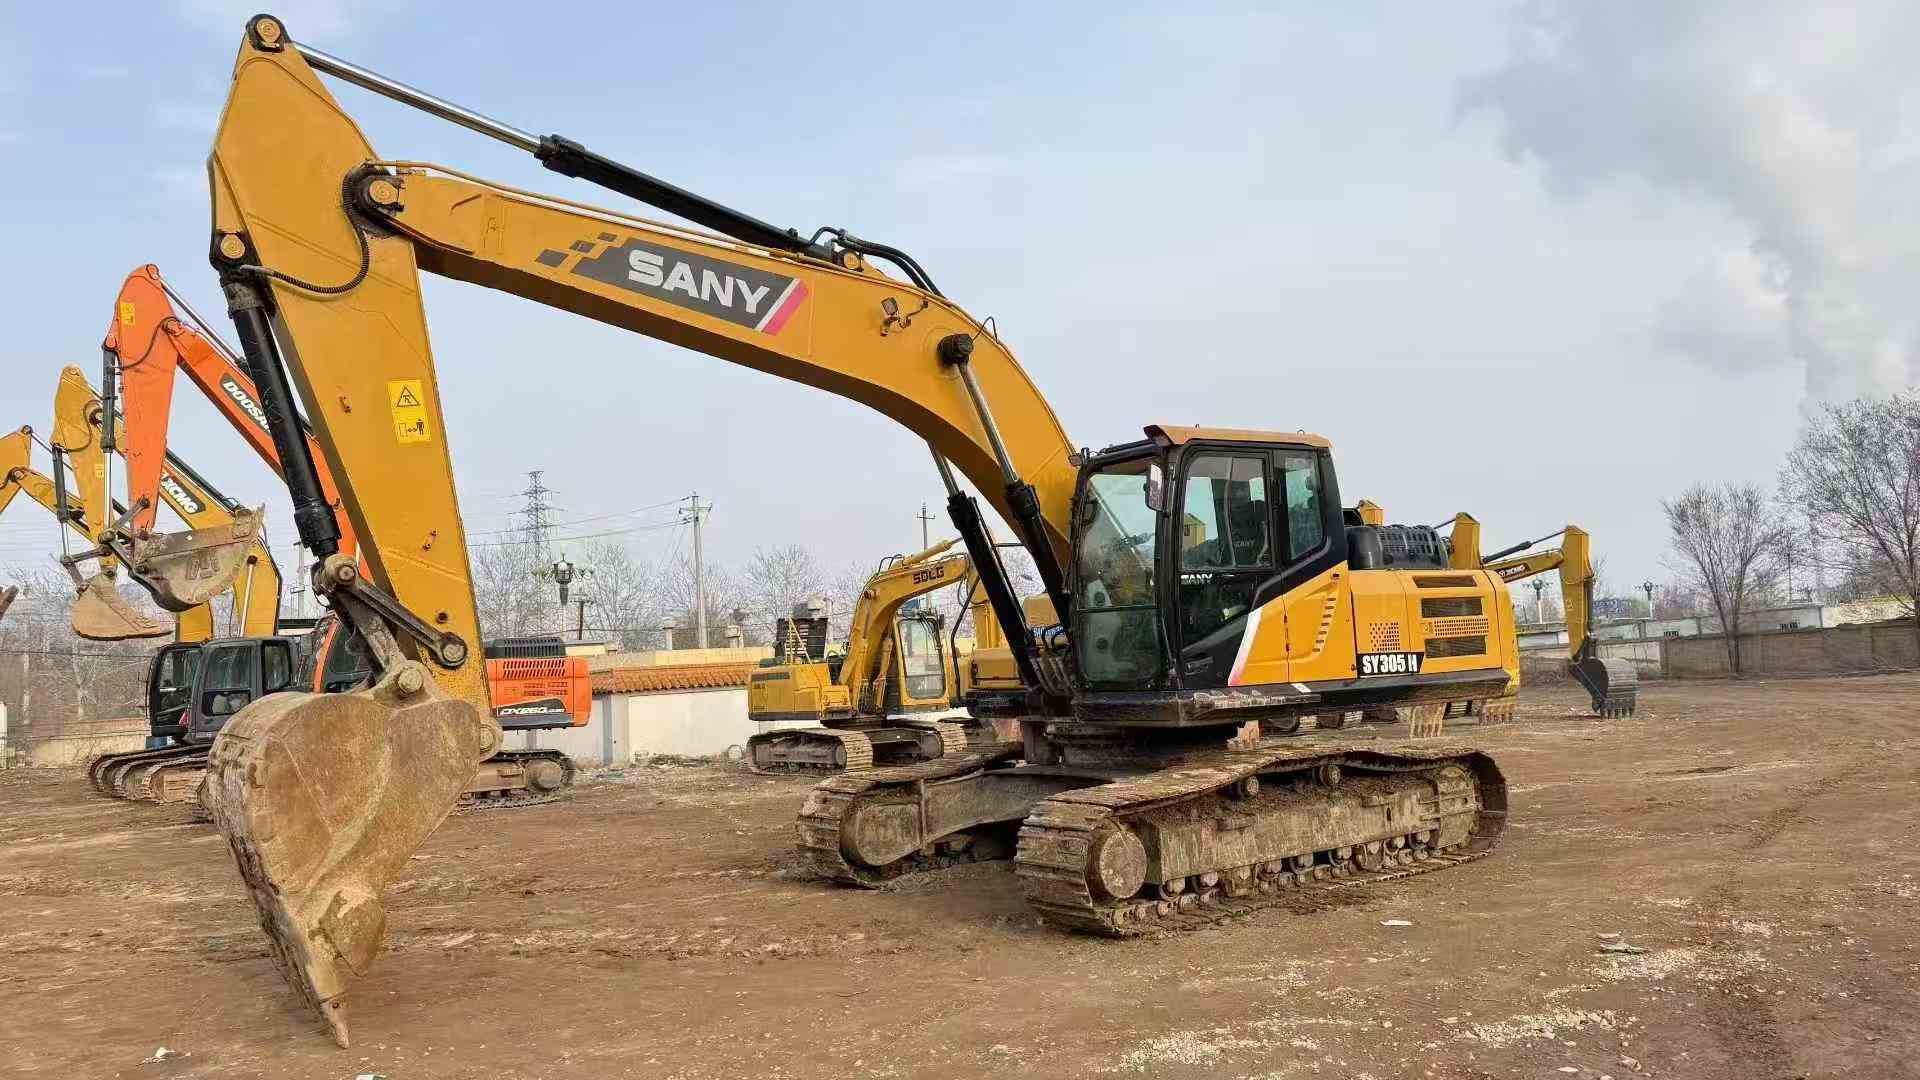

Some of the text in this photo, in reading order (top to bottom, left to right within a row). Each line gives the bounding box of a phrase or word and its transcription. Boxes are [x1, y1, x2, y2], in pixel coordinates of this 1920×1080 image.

[627, 249, 770, 314] SANY
[222, 381, 271, 433] DOOSA
[1362, 653, 1406, 674] SY305
